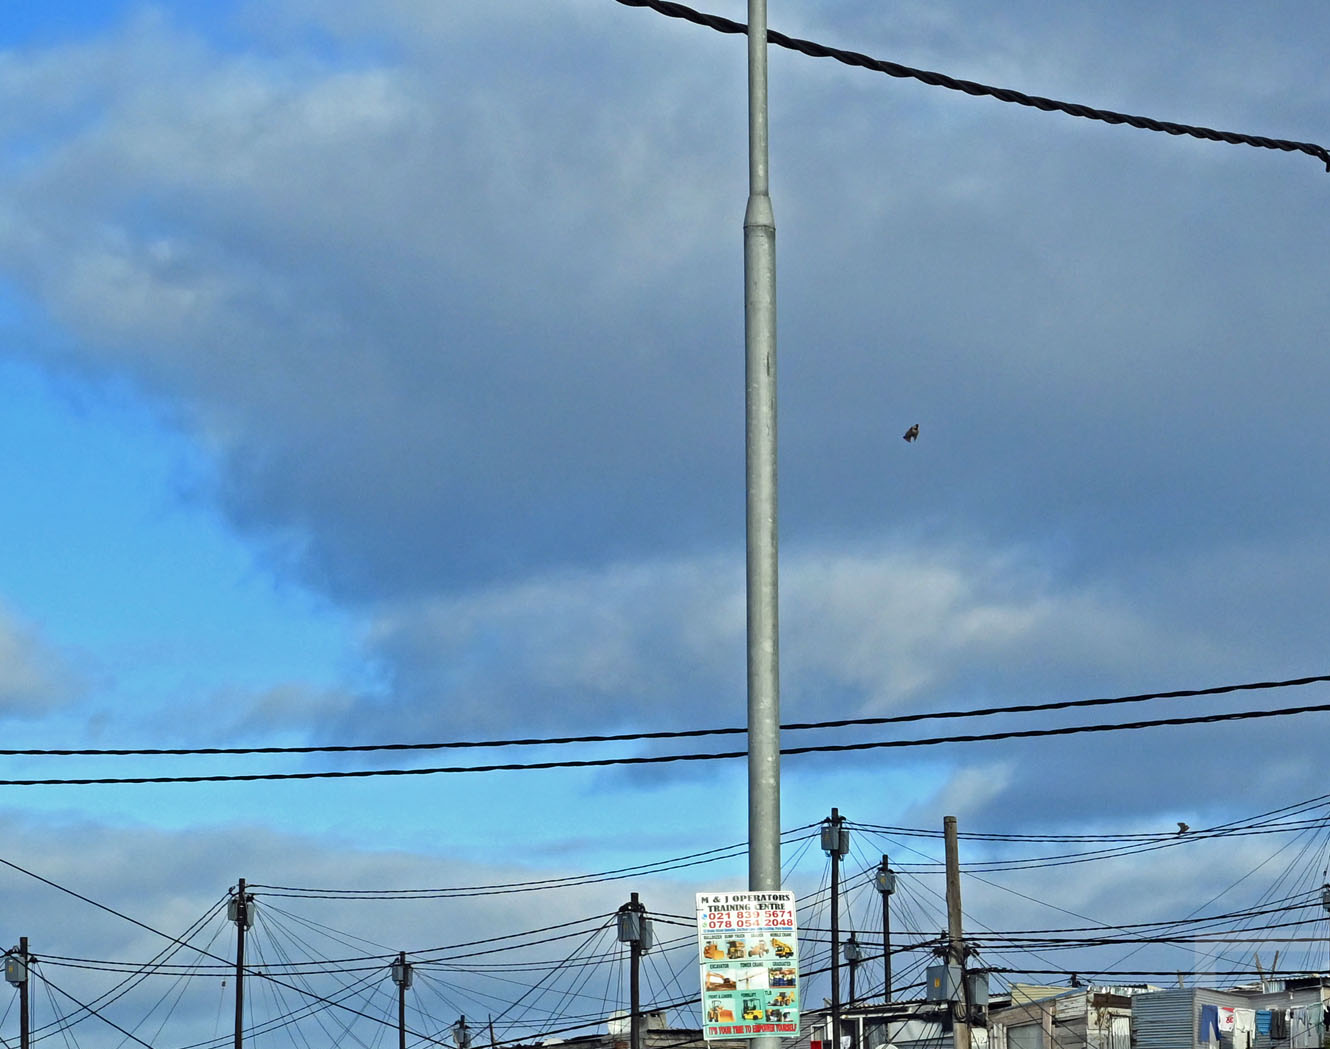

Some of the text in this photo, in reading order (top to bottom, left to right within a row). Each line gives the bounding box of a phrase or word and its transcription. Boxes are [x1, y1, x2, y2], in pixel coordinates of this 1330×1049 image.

[701, 896, 709, 904] M
[725, 895, 729, 904] J
[732, 894, 791, 902] OPERATORS
[707, 902, 786, 913] TRAINING CENTRE
[708, 910, 793, 921] 021 839 5671
[708, 918, 794, 929] 078 054 2048
[708, 1023, 797, 1035] IT'S YOUR TIME TO EMPOWER YOURSELF
